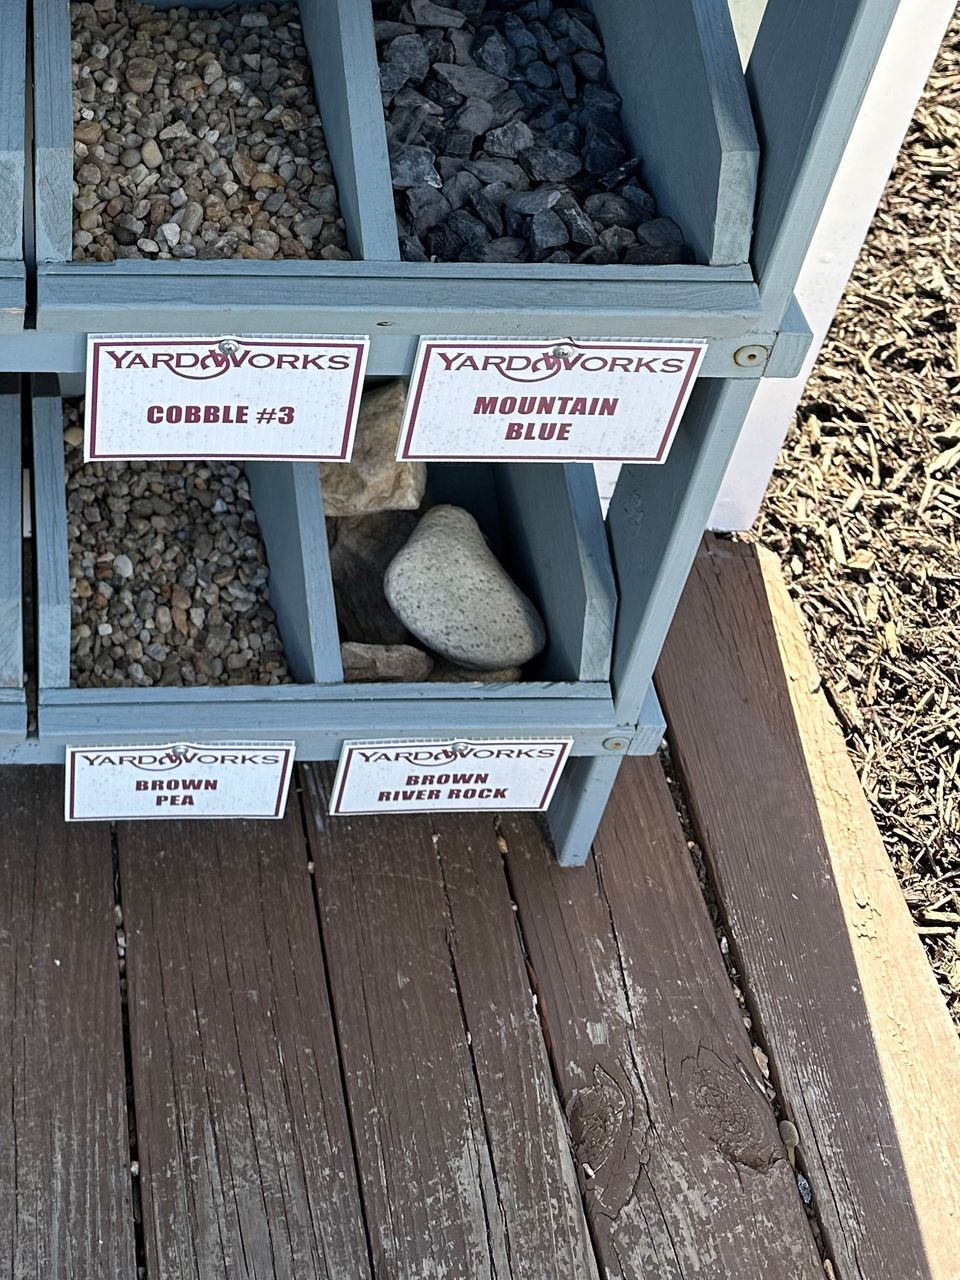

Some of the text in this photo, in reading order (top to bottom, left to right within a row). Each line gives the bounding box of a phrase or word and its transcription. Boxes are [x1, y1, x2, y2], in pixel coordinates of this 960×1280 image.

[473, 396, 619, 416] MOUNTAIN
[146, 405, 295, 425] COBBLE #3
[504, 422, 572, 441] BLUE
[135, 779, 218, 791] BROWN
[405, 773, 489, 786] BROWN
[155, 794, 195, 806] PEA
[377, 788, 507, 802] RIVER ROCK
